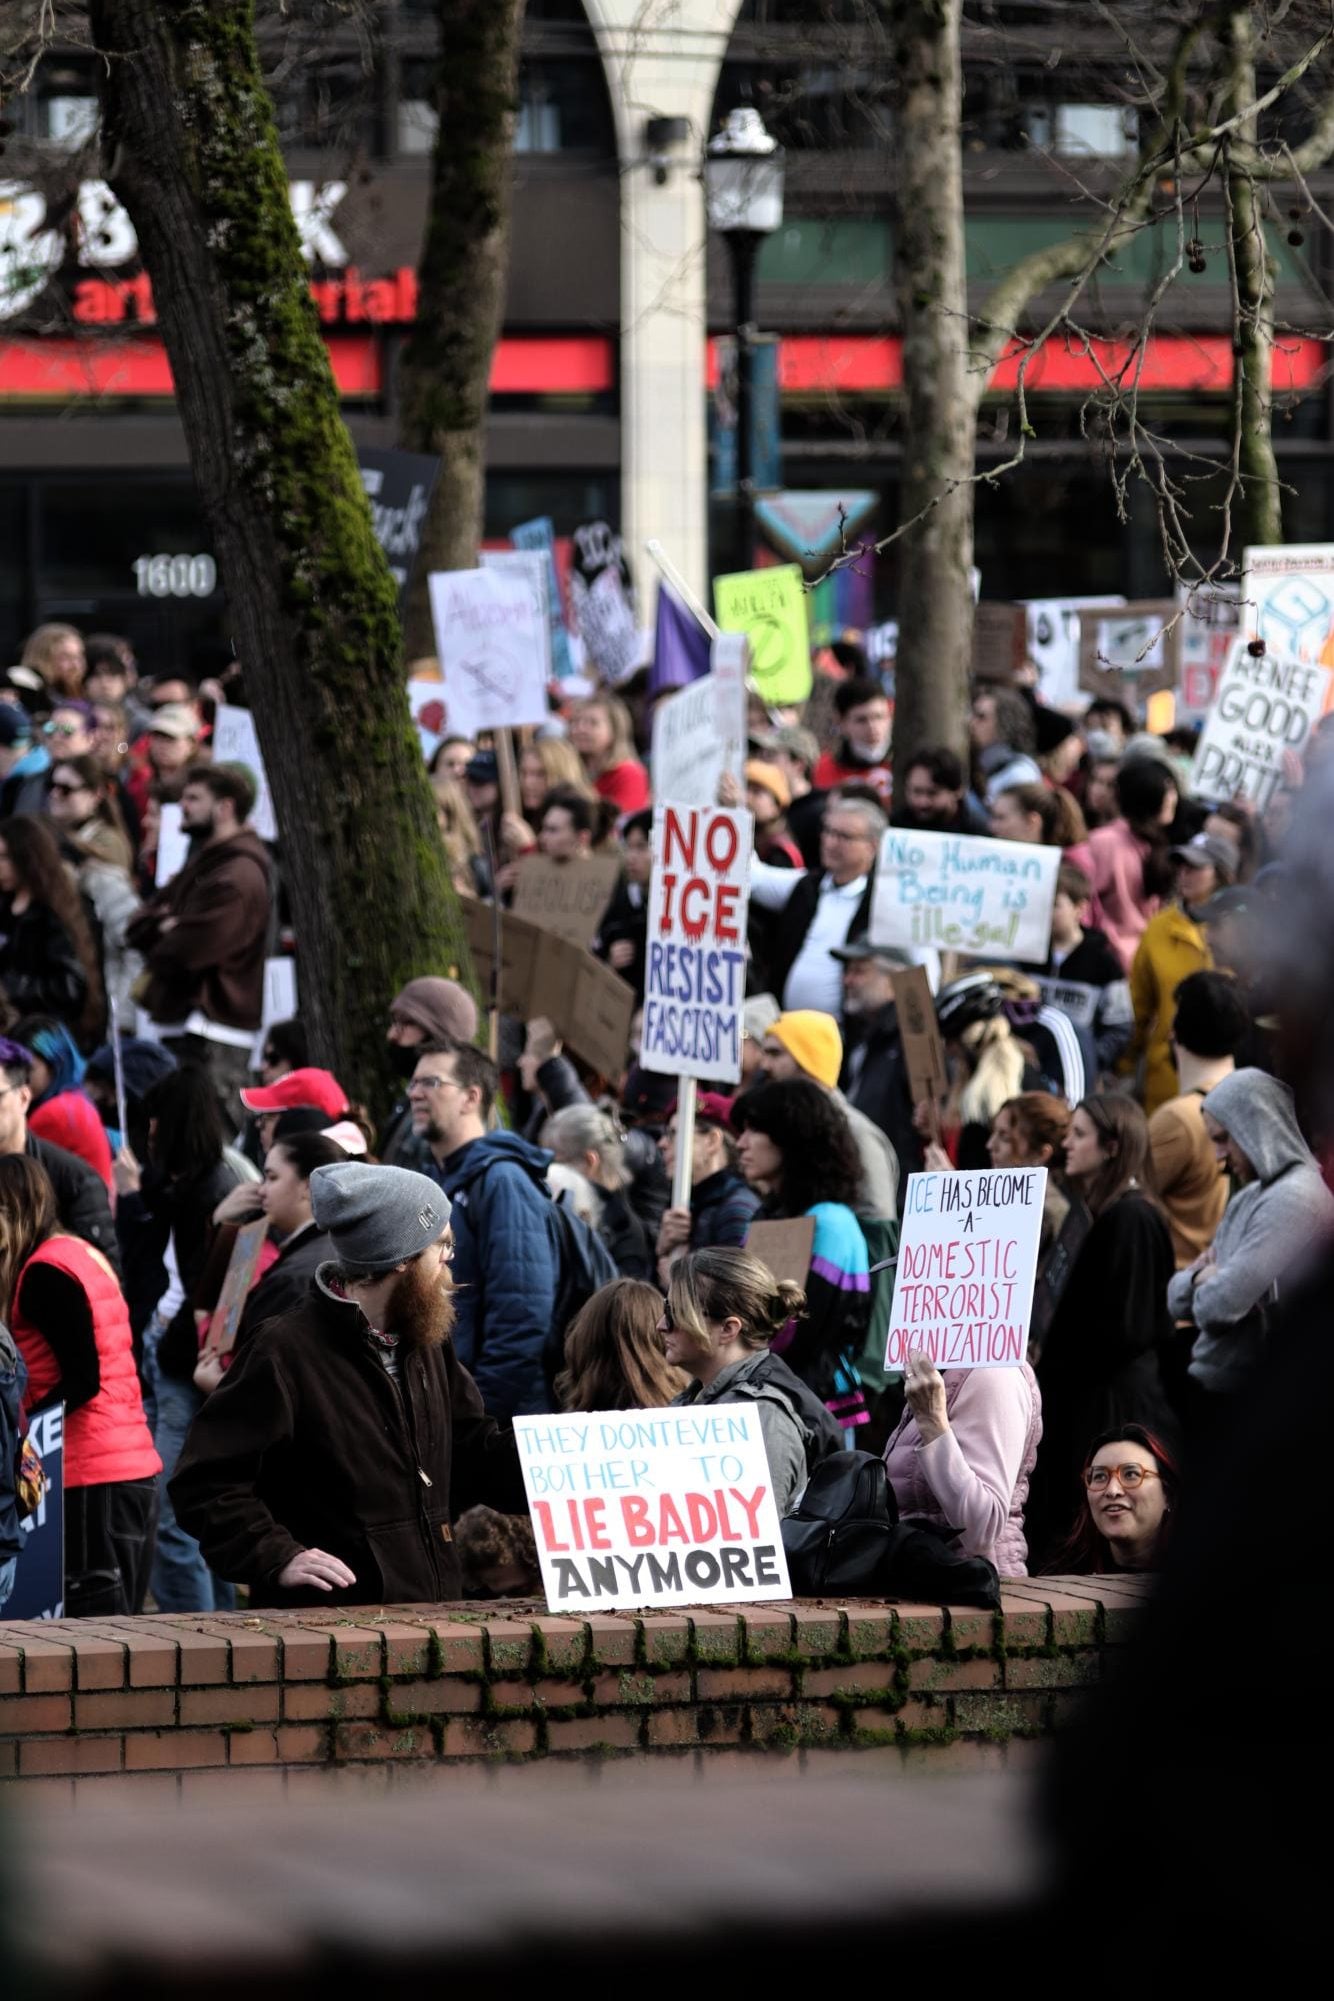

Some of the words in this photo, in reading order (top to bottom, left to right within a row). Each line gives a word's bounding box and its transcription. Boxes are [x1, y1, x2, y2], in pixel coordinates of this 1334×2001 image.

[131, 553, 217, 597] 1600
[1219, 682, 1309, 745] GOOD
[663, 806, 740, 876] NO
[887, 834, 925, 866] No
[941, 840, 1042, 880] Human
[660, 873, 741, 941] ICE
[898, 868, 985, 927] Being
[1001, 879, 1028, 910] is
[649, 941, 745, 1006] RESIST
[644, 1001, 739, 1064] FASCISM
[908, 1175, 938, 1214] ICE
[940, 1177, 973, 1213] HAS
[976, 1174, 1037, 1207] BECOME
[903, 1239, 1018, 1280] DOMESTIC
[900, 1282, 1019, 1323] TERRORIST
[888, 1321, 1023, 1365] ORGANIZATION
[519, 1424, 590, 1455] THEY
[675, 1416, 750, 1445] EVEN
[529, 1459, 656, 1494] BOTHER
[690, 1454, 744, 1484] TO
[532, 1496, 613, 1552] LIE
[619, 1485, 767, 1548] BADLY
[550, 1544, 782, 1599] ANYMORE
